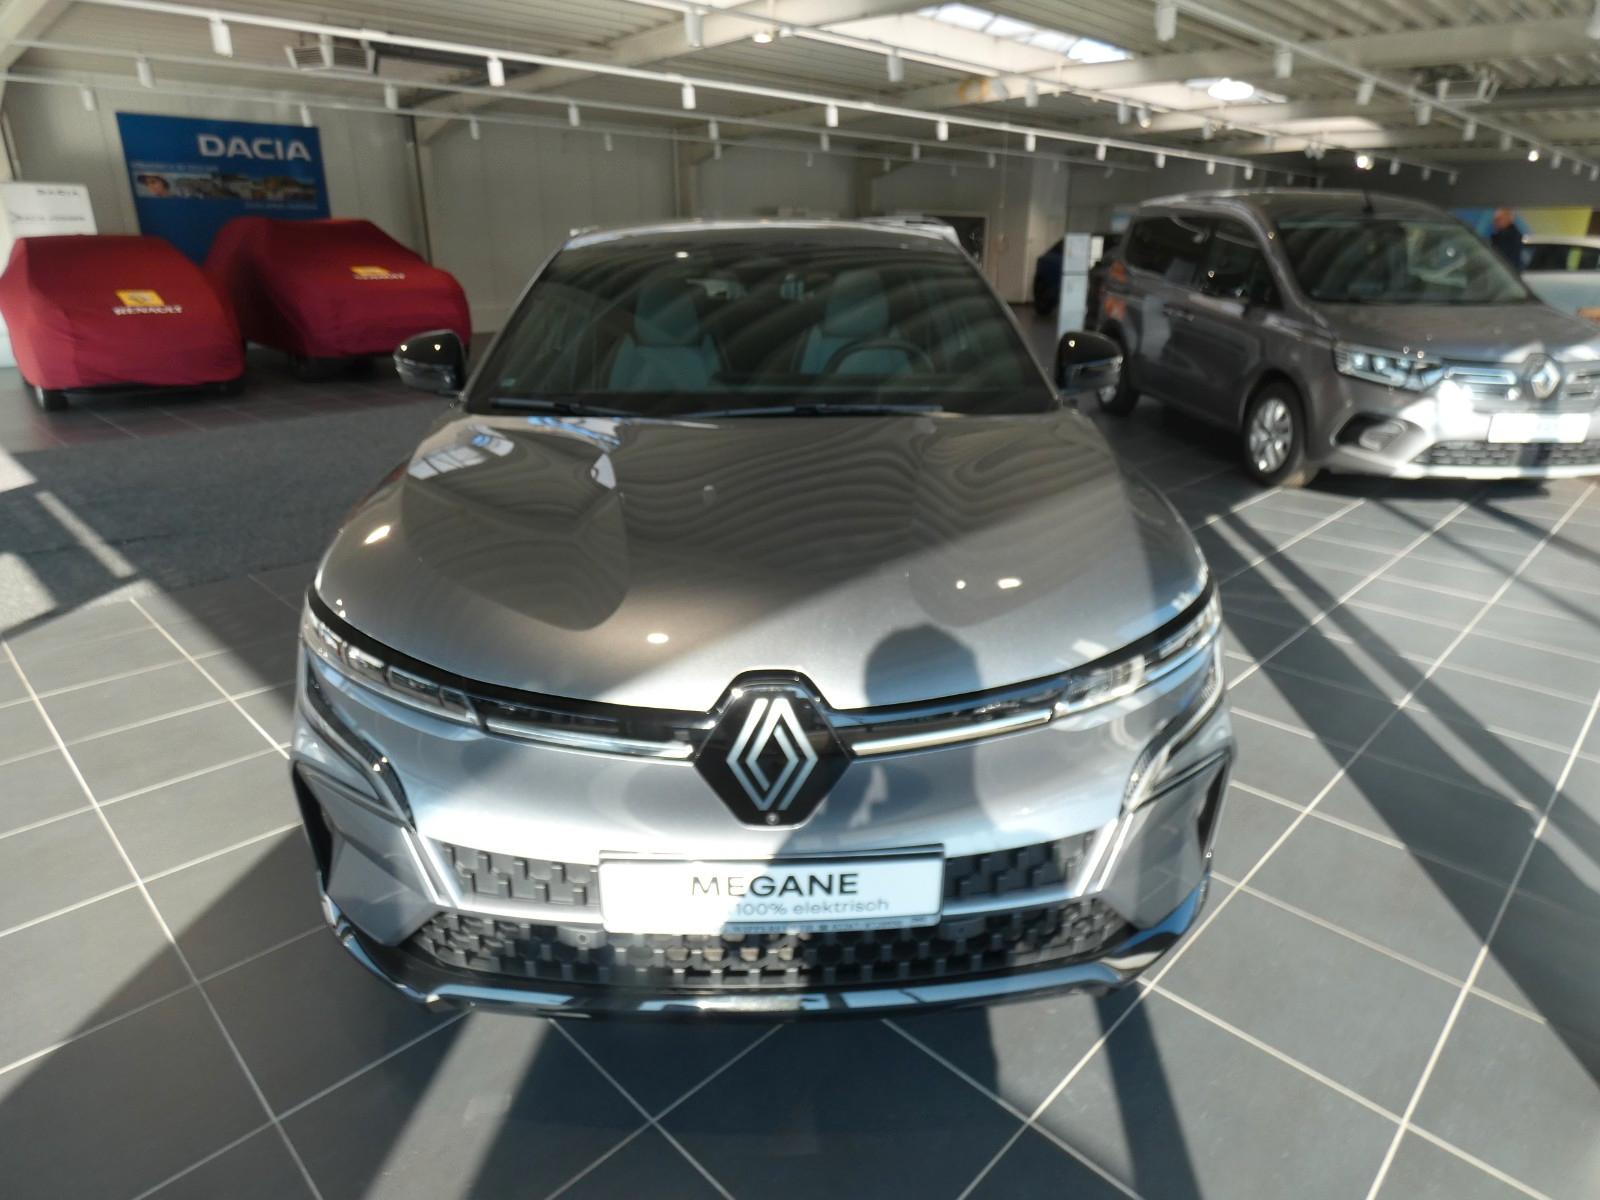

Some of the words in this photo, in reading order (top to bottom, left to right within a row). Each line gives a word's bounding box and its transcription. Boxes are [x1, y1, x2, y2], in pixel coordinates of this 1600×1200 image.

[198, 134, 311, 161] DACIA
[692, 873, 859, 897] MEGANE
[735, 903, 788, 916] 100%
[793, 899, 890, 914] elektrisch
